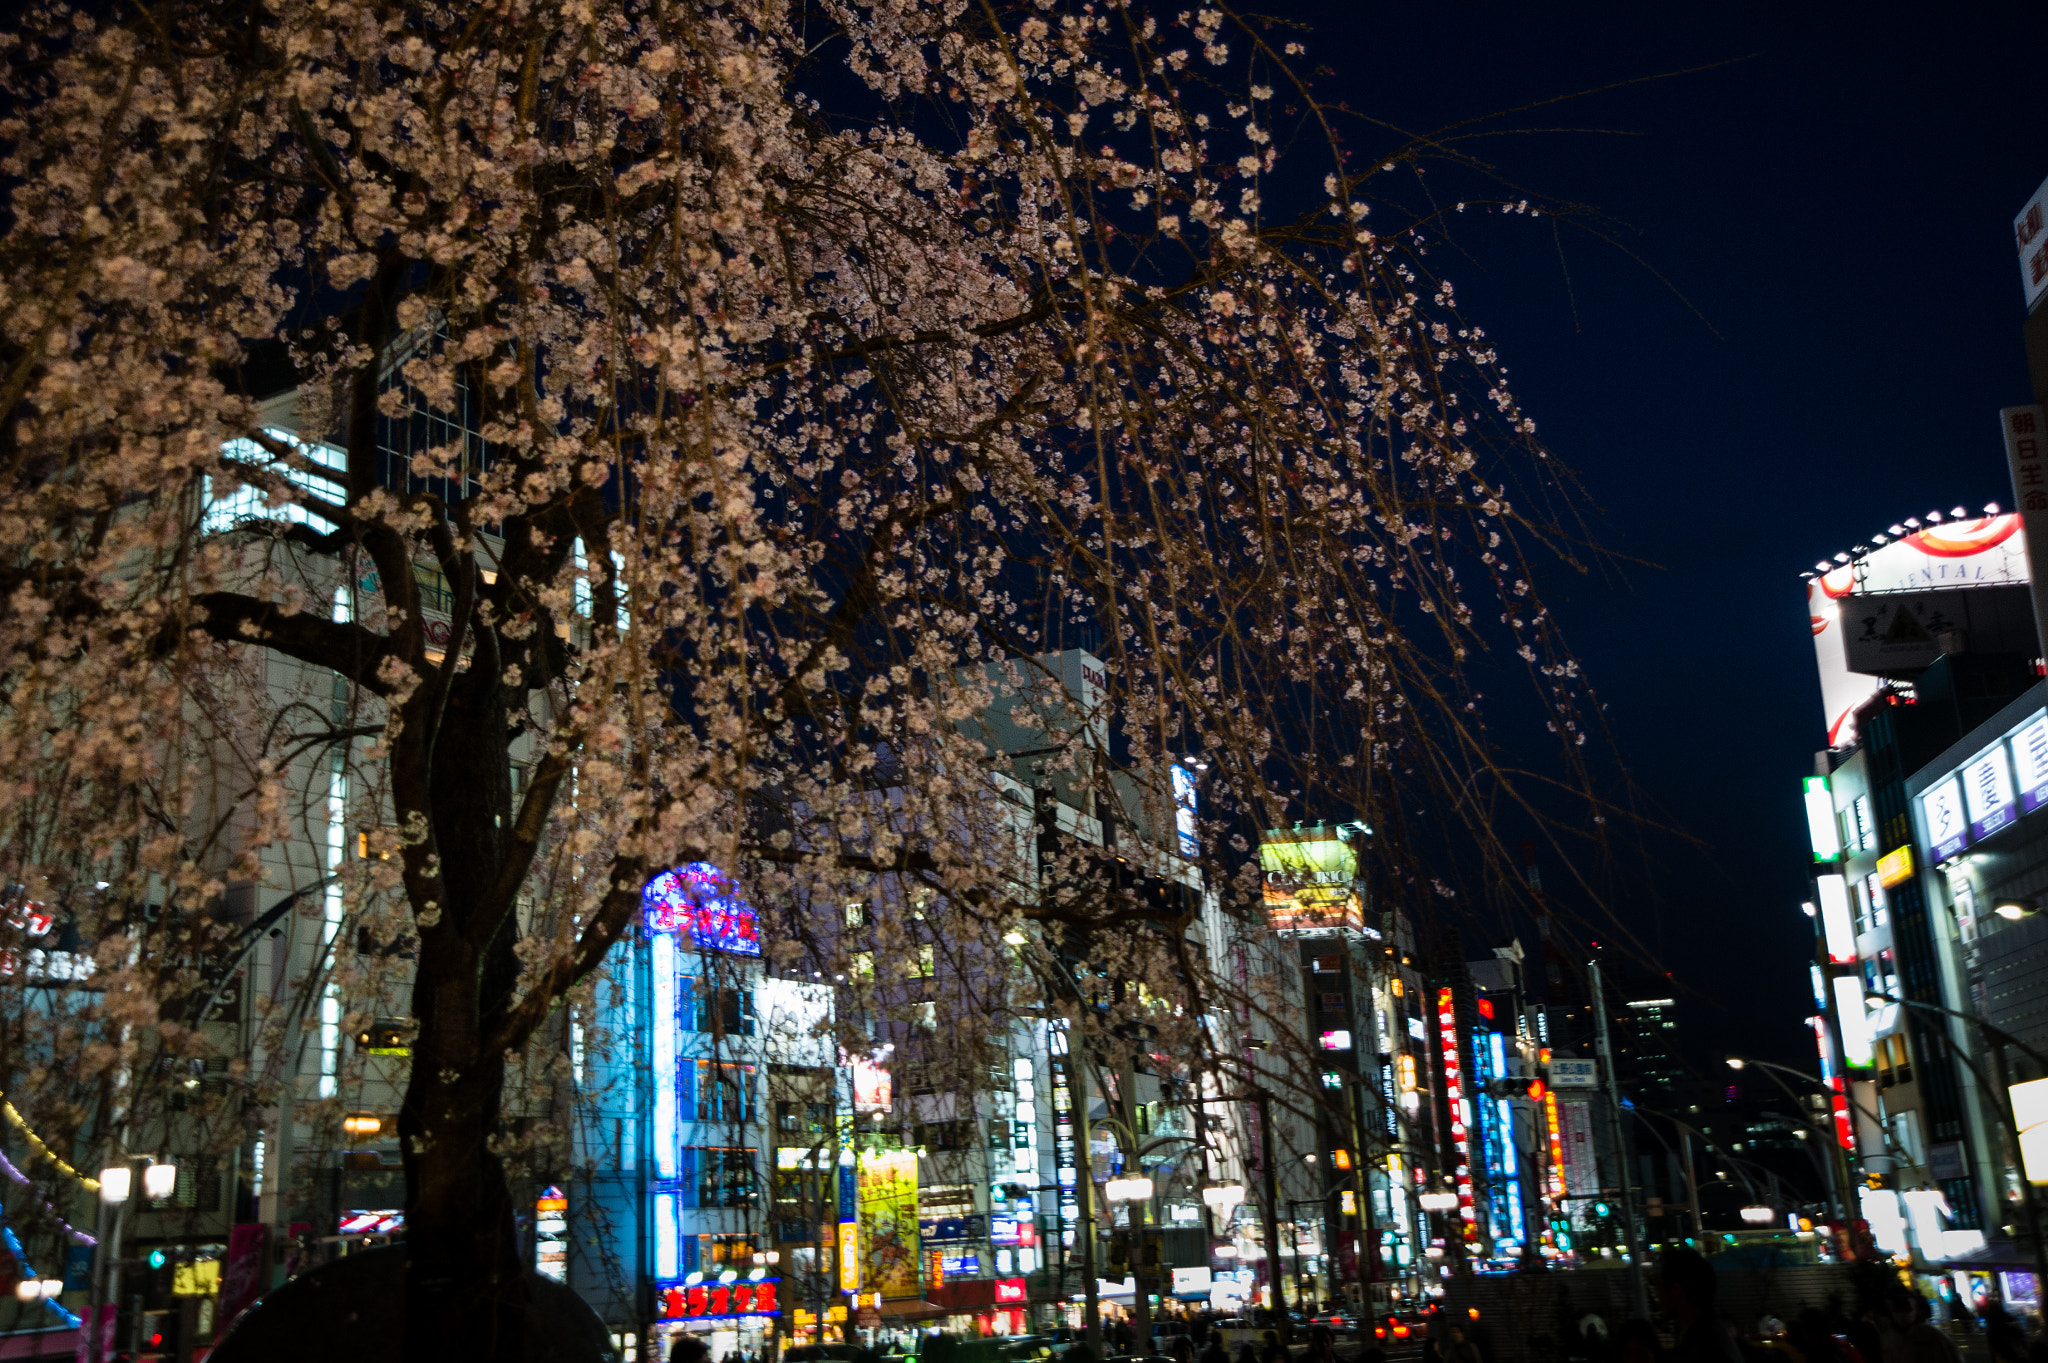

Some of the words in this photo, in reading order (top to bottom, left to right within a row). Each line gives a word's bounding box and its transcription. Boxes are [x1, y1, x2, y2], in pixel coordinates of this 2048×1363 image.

[2010, 412, 2048, 511] 朝日生命
[666, 1282, 777, 1318] カラオケ館
